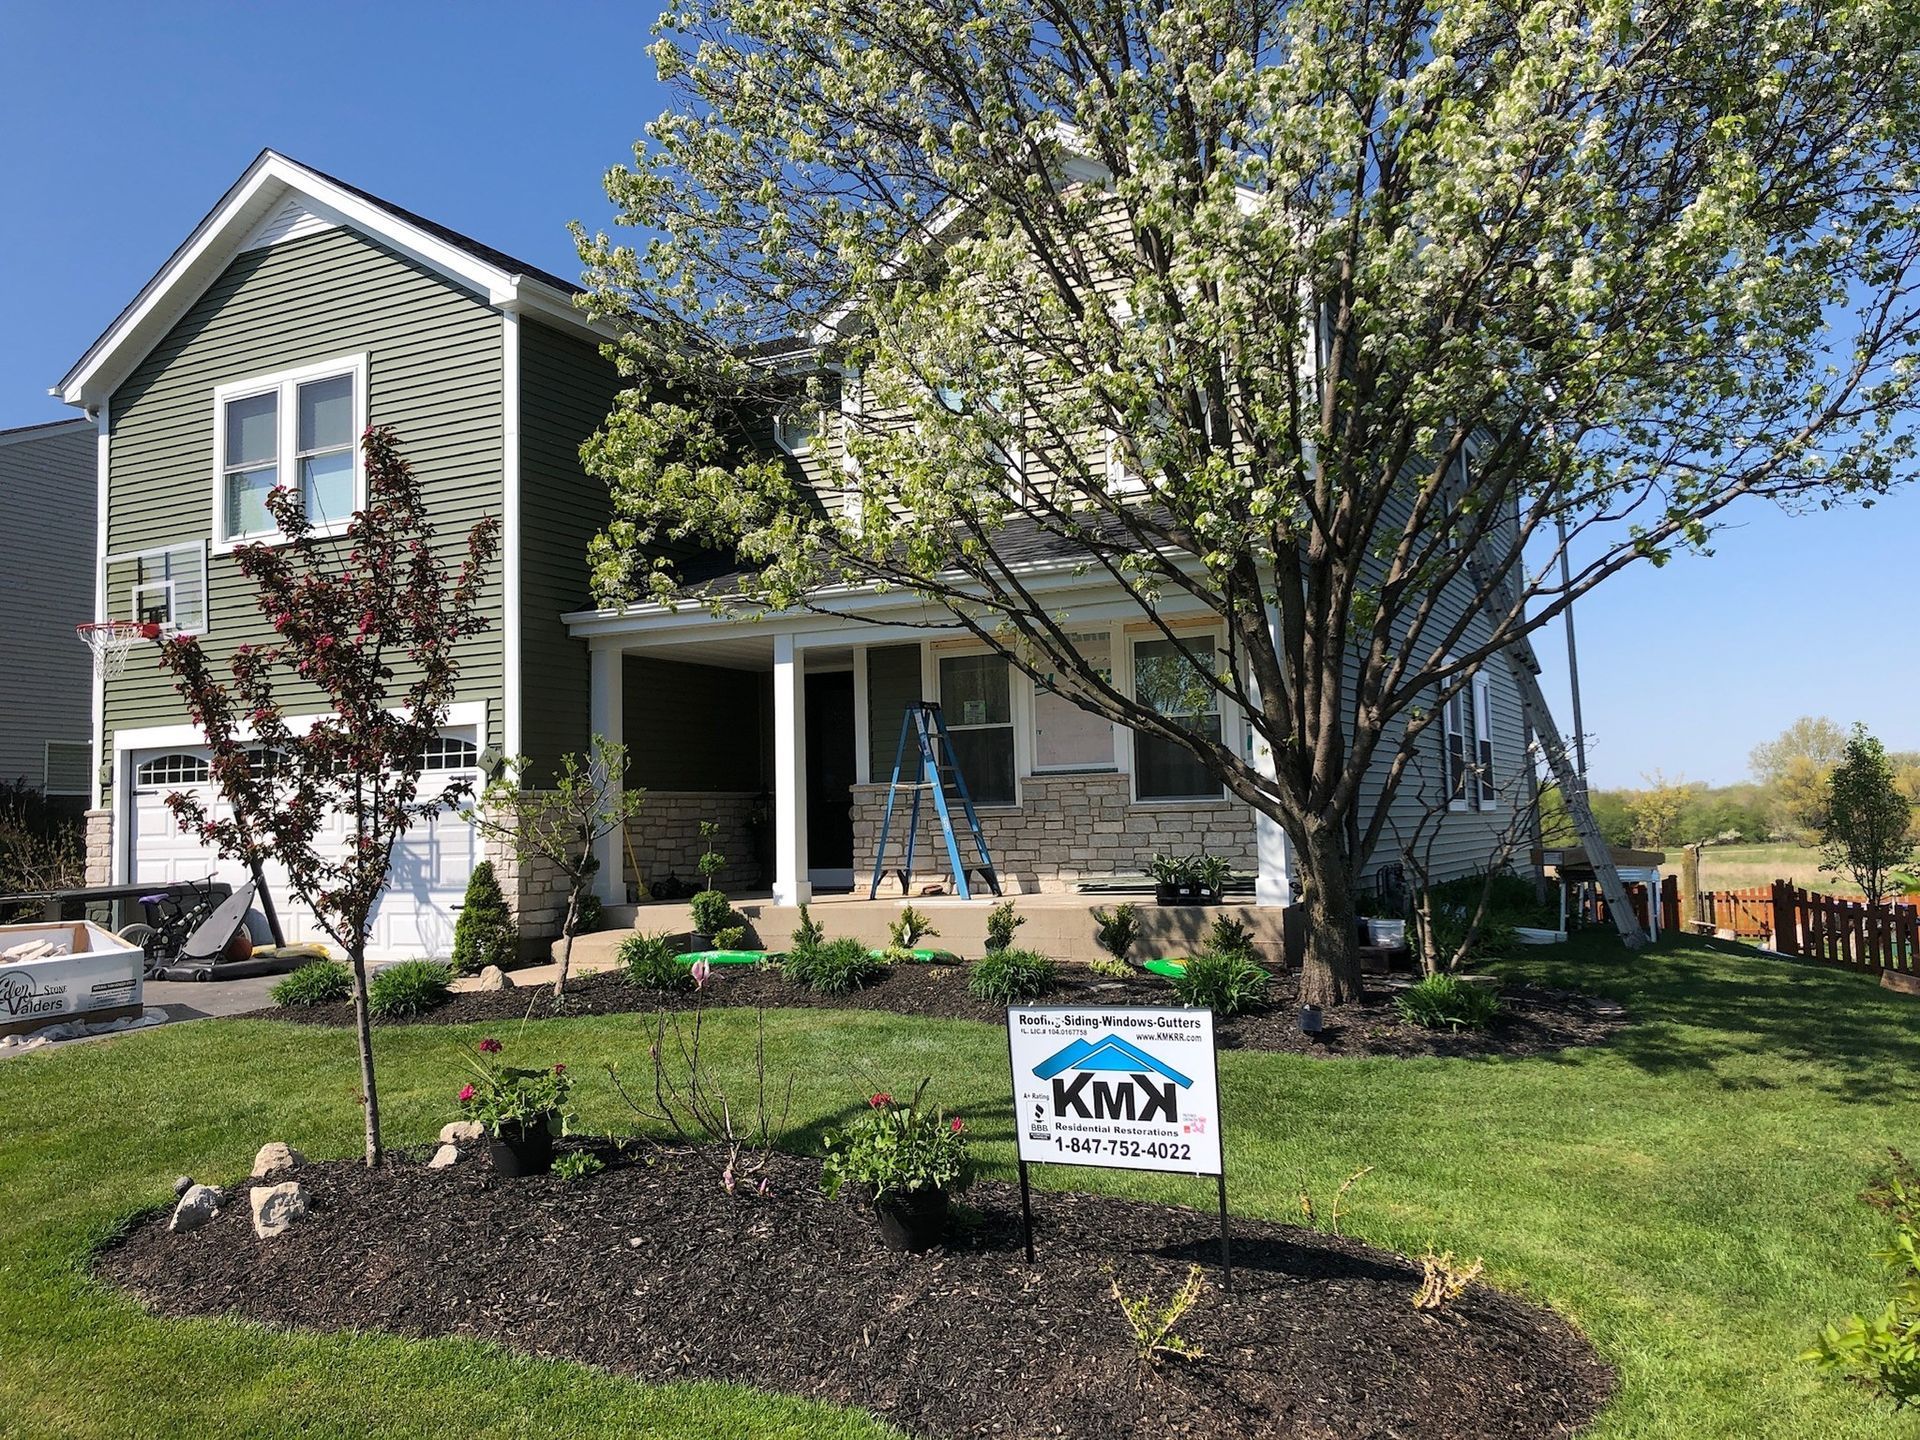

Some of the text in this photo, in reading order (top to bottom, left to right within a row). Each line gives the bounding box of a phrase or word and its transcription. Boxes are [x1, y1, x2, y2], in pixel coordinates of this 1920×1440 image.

[8, 996, 63, 1016] Valders
[1136, 1031, 1202, 1042] www.KMKRR.com
[1032, 1092, 1050, 1101] Rating
[1031, 1123, 1049, 1132] BBB
[1055, 1122, 1179, 1137] Residential Restorations
[1055, 1136, 1192, 1160] 1-847-752-4022
